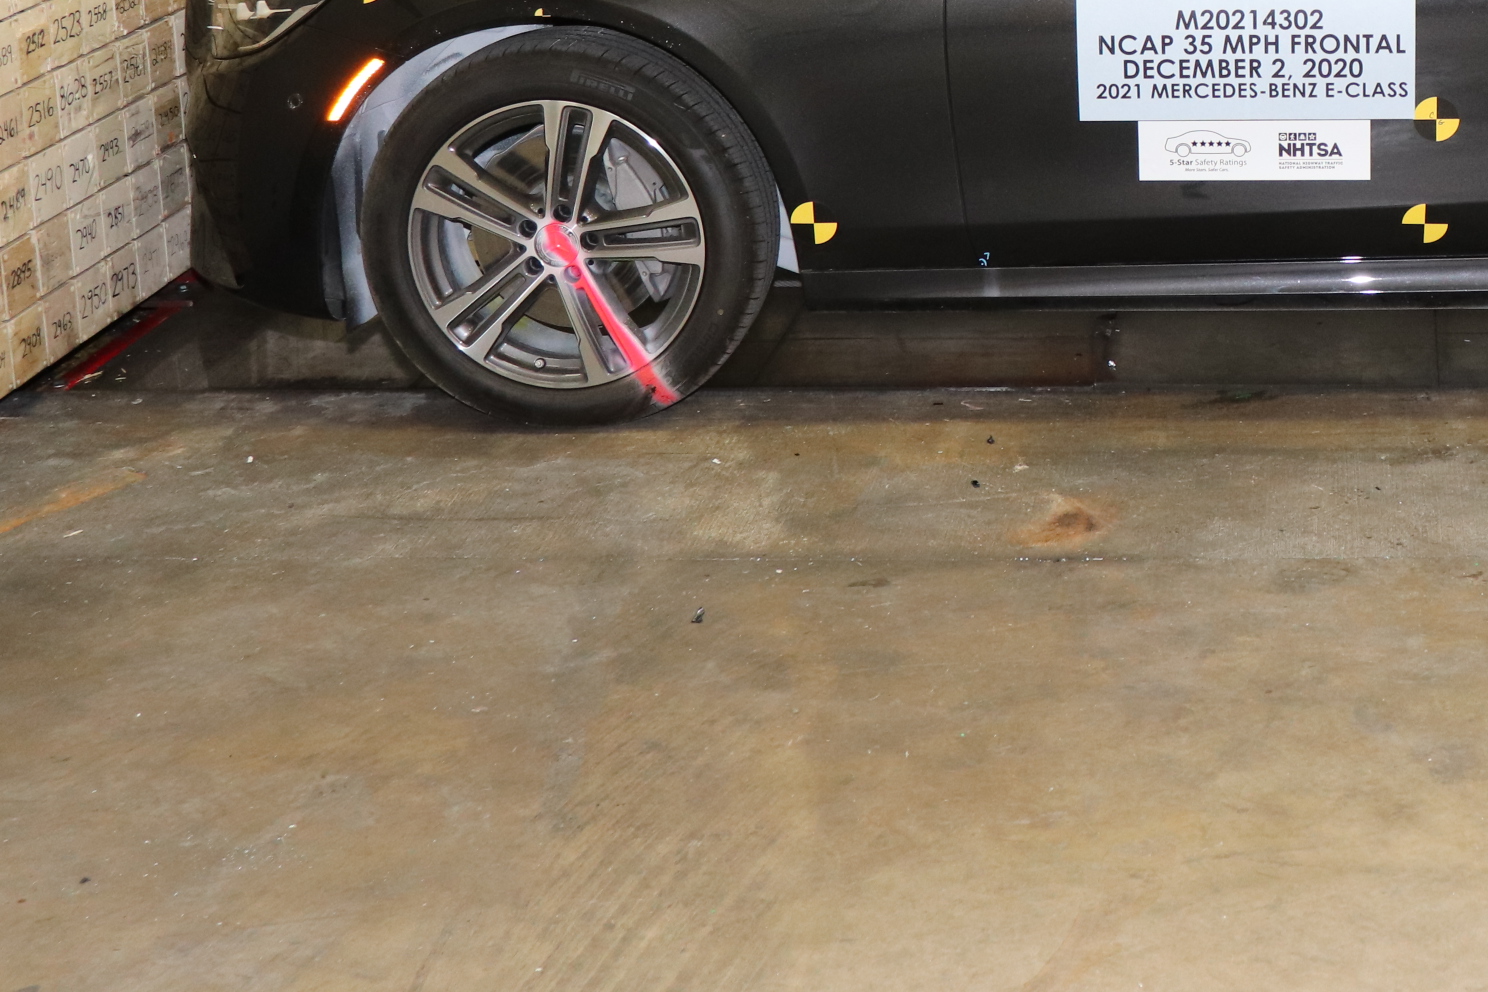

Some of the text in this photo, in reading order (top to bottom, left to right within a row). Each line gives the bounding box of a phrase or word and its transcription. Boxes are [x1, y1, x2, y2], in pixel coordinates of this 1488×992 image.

[53, 10, 83, 45] 2523
[1175, 9, 1324, 31] M20214302
[25, 29, 45, 55] 2512
[1099, 34, 1406, 55] NCAP 35 MPH FRONTAL
[93, 70, 114, 95] 2557
[1123, 58, 1364, 81] DECEMBER 2, 2020
[1096, 82, 1409, 99] 2021 MERCEDES-BENZ E-CLASS
[28, 98, 54, 128] 2516
[100, 138, 120, 162] 2493
[1278, 142, 1343, 157] NHTSA
[69, 157, 90, 183] 2470
[1195, 159, 1218, 167] Safety
[1220, 159, 1247, 167] Ratings
[34, 166, 63, 201] 2490
[76, 219, 97, 250] 2940
[111, 263, 137, 298] 2973
[80, 283, 107, 319] 2950
[52, 312, 73, 339] 2963
